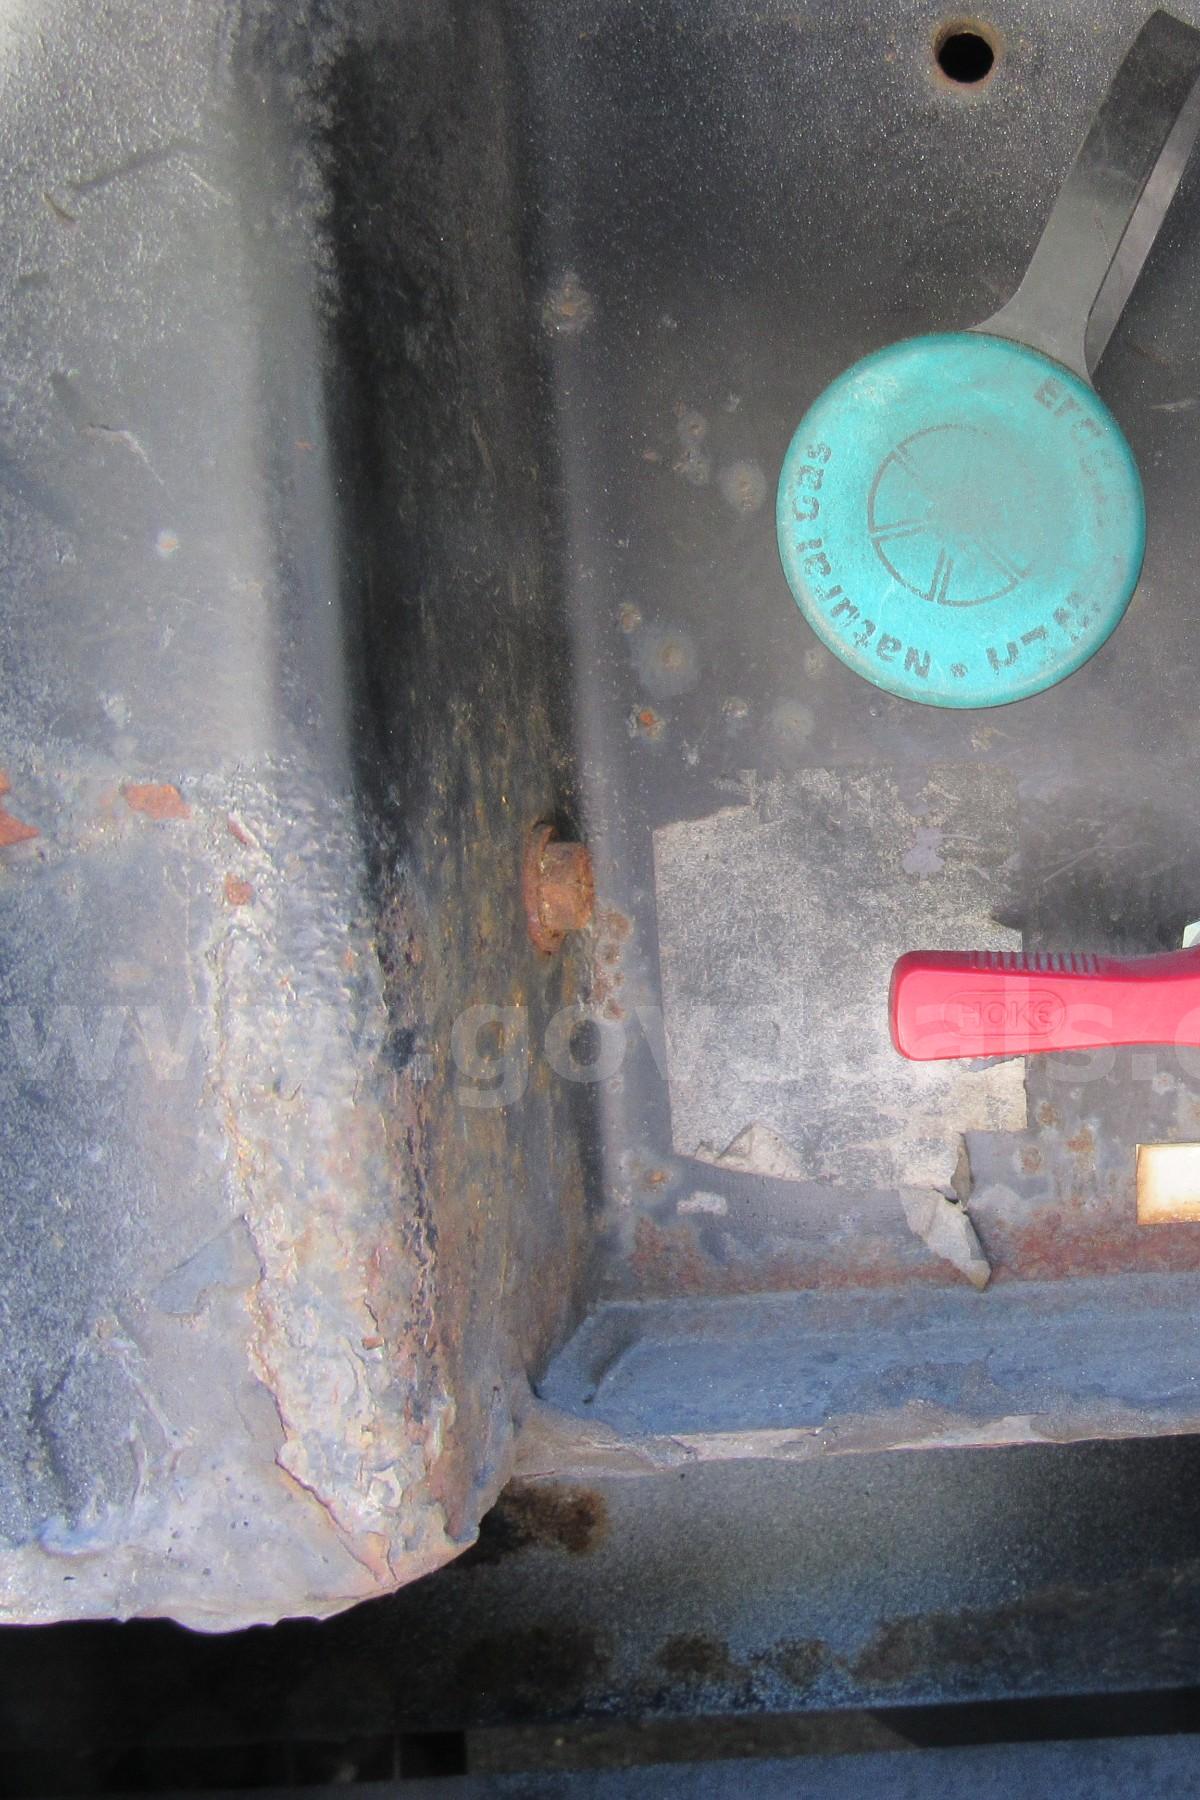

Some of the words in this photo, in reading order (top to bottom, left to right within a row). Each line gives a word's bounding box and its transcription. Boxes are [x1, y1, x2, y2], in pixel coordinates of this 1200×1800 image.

[792, 441, 833, 522] Gas
[796, 537, 931, 679] Natural
[957, 1000, 1054, 1031] HOKE
